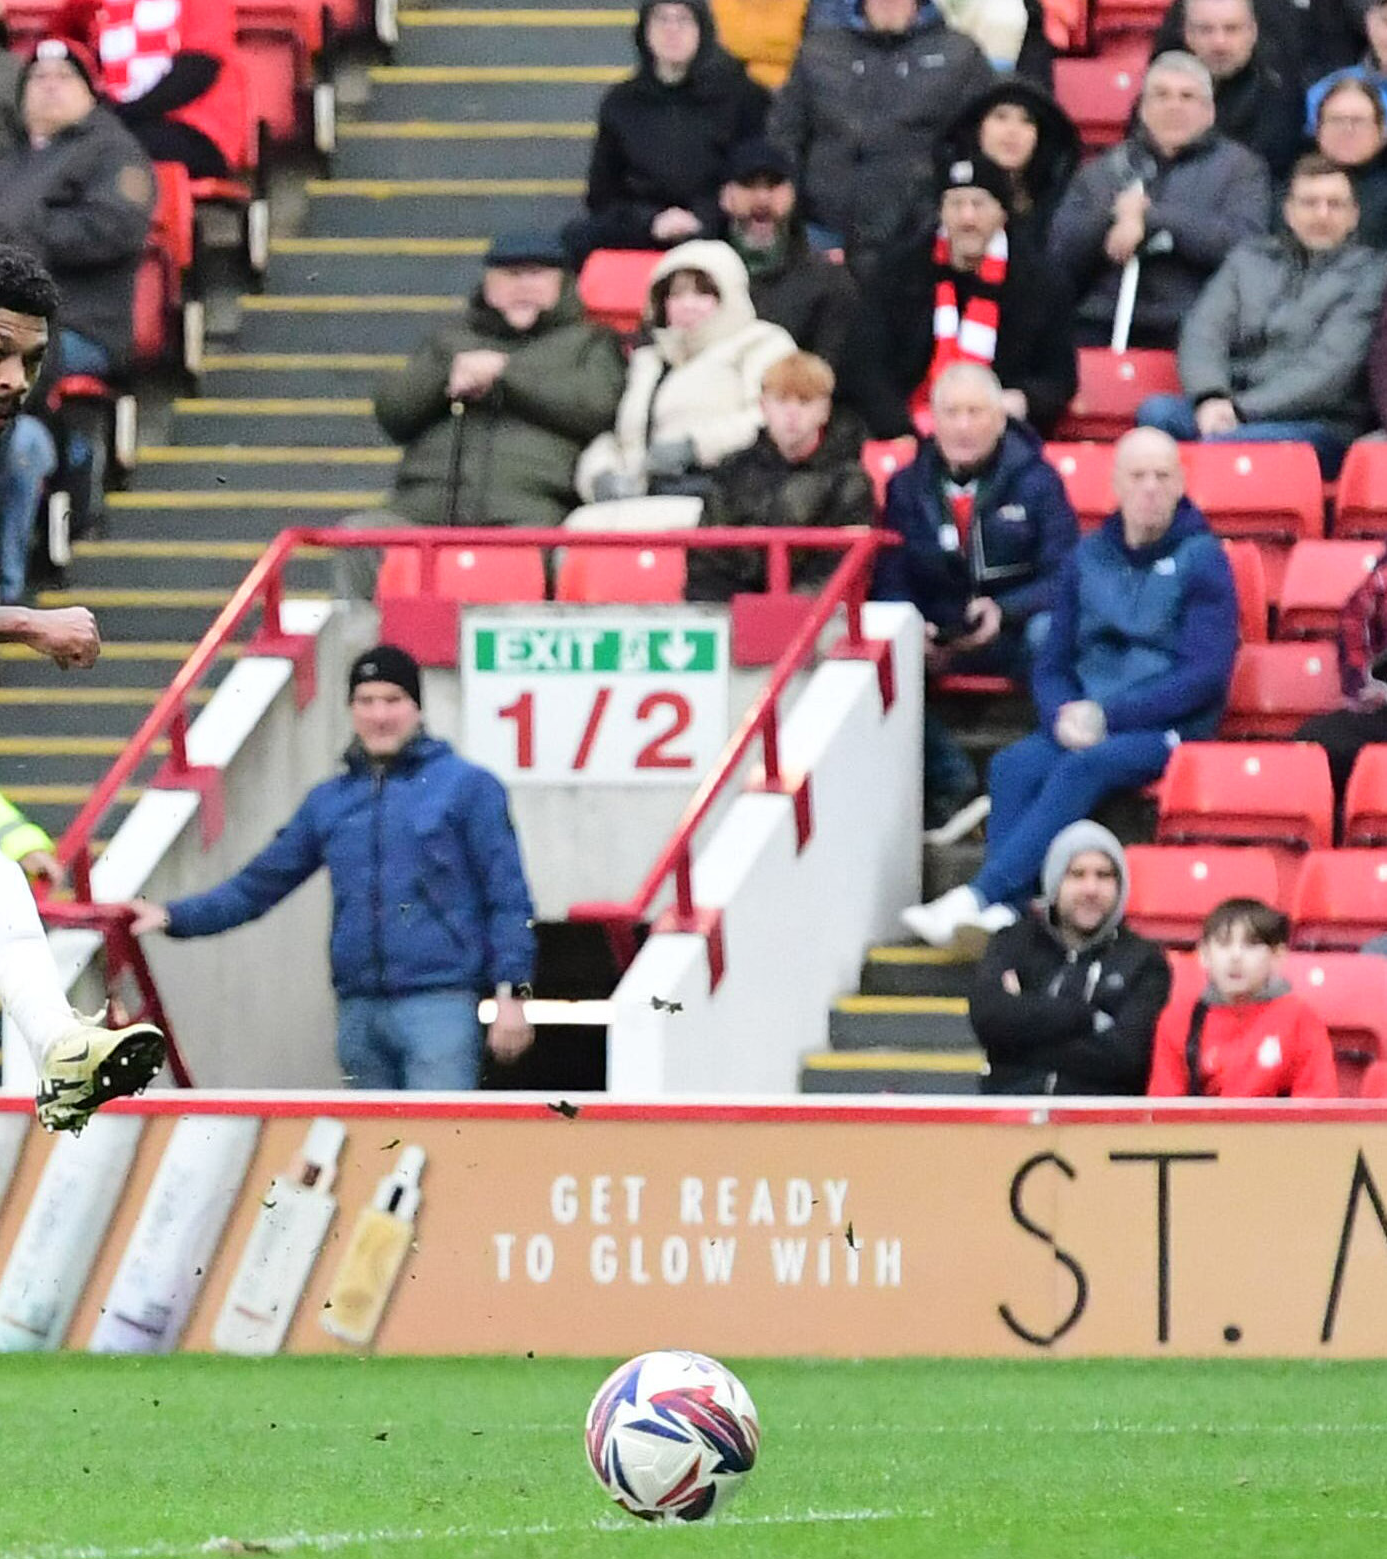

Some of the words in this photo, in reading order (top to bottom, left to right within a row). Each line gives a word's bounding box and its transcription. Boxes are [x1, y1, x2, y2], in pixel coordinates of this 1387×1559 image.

[495, 630, 606, 672] EXIT
[549, 1174, 647, 1226] GET
[678, 1176, 850, 1228] READY
[492, 1232, 556, 1284] TO
[588, 1233, 738, 1286] GLOW
[770, 1236, 903, 1289] WITH
[998, 1150, 1243, 1348] ST.
